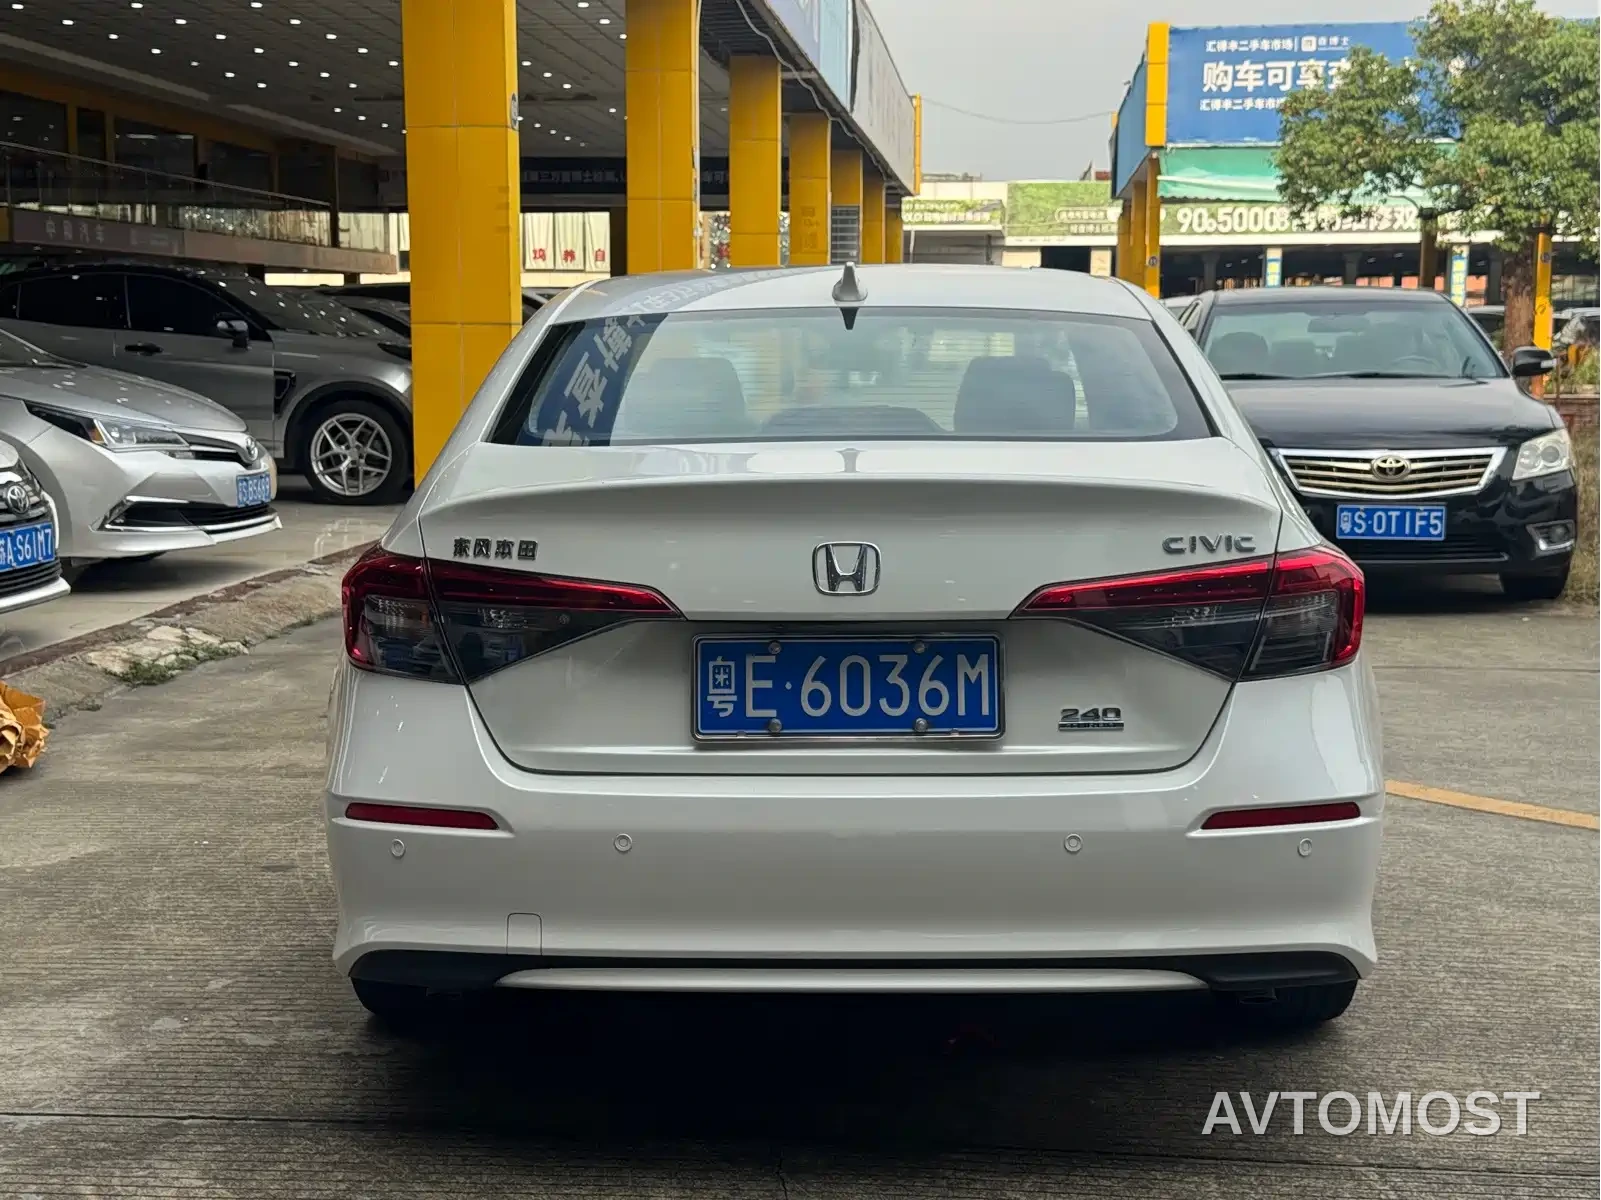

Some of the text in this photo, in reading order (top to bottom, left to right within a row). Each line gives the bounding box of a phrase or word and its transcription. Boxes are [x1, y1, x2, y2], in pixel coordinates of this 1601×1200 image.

[453, 537, 538, 560] 东风本田
[1162, 534, 1256, 553] CIVIC
[1061, 707, 1121, 721] 240
